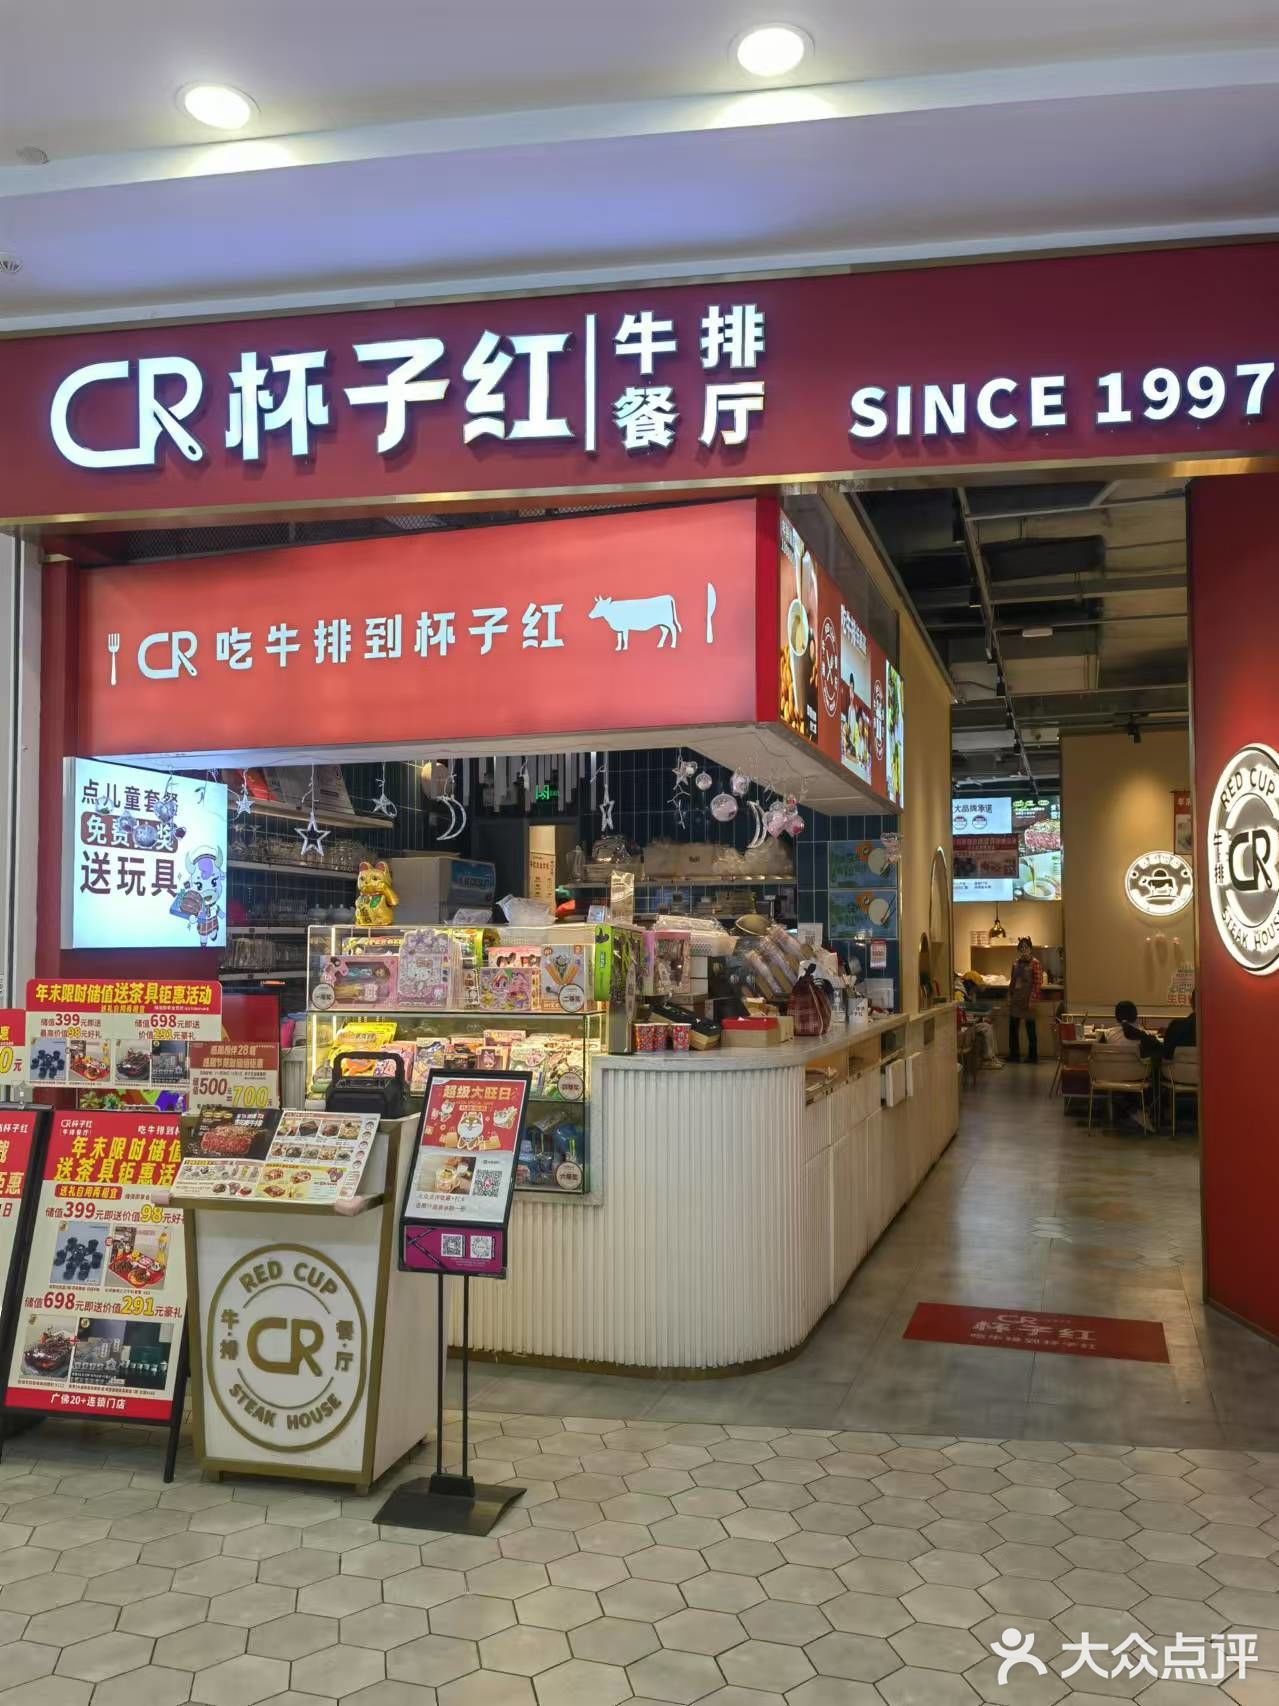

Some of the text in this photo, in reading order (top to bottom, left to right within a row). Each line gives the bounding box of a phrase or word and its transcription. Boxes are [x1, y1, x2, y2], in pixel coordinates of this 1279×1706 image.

[615, 304, 766, 374] 牛排
[225, 329, 574, 461] 杯子红
[849, 361, 1276, 439] SINCE 1997
[613, 381, 766, 450] 餐厅
[215, 603, 564, 671] 吃牛排到杯子红
[1220, 771, 1243, 810] RED
[1249, 767, 1276, 796] CUP
[86, 812, 178, 852] 免费奖
[80, 850, 178, 898] 送玩具
[1222, 907, 1279, 950] STEAK HOUS
[35, 982, 213, 1006] 年末限时储值送茶具钜惠活动
[41, 1013, 102, 1027] 储值399元即送
[135, 1014, 200, 1028] 储值698元即送
[199, 1077, 228, 1095] 500
[232, 1086, 269, 1108] 700
[71, 1136, 181, 1163] 年末限时储值
[54, 1157, 176, 1186] 送茶具钜惠活
[59, 1186, 118, 1199] 送礼自用两相宜
[45, 1201, 184, 1224] 储值399元即送价值98元好
[238, 1260, 338, 1296] RED CUP
[25, 1292, 182, 1317] 储值698元即送价值291元豪礼
[229, 1383, 343, 1431] STEAK HOUSE
